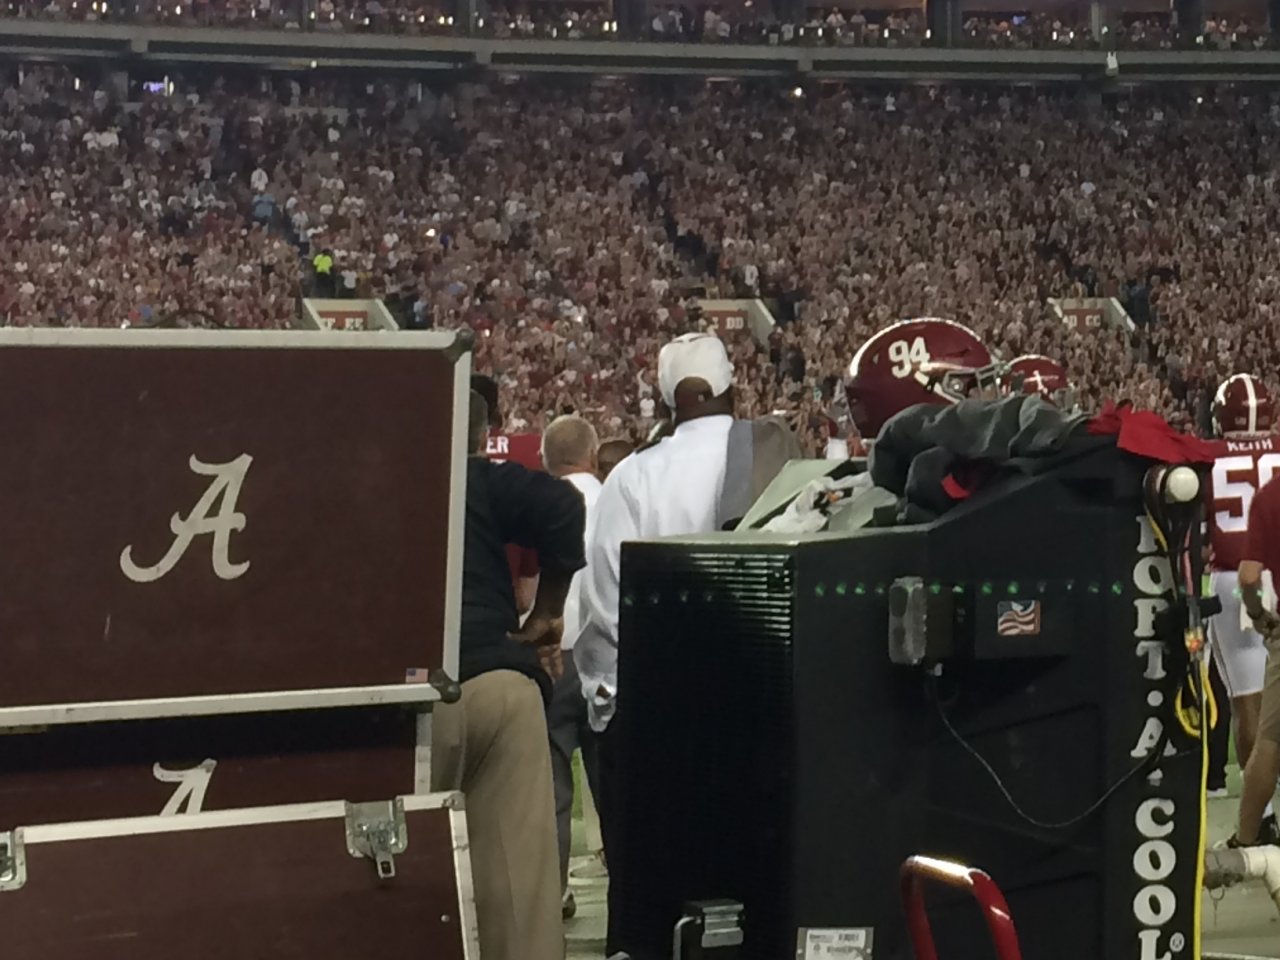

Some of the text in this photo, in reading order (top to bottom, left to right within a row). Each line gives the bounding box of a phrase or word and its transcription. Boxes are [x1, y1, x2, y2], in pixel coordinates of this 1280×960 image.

[888, 337, 931, 379] 94
[1226, 438, 1273, 452] KEITH
[119, 453, 253, 583] A
